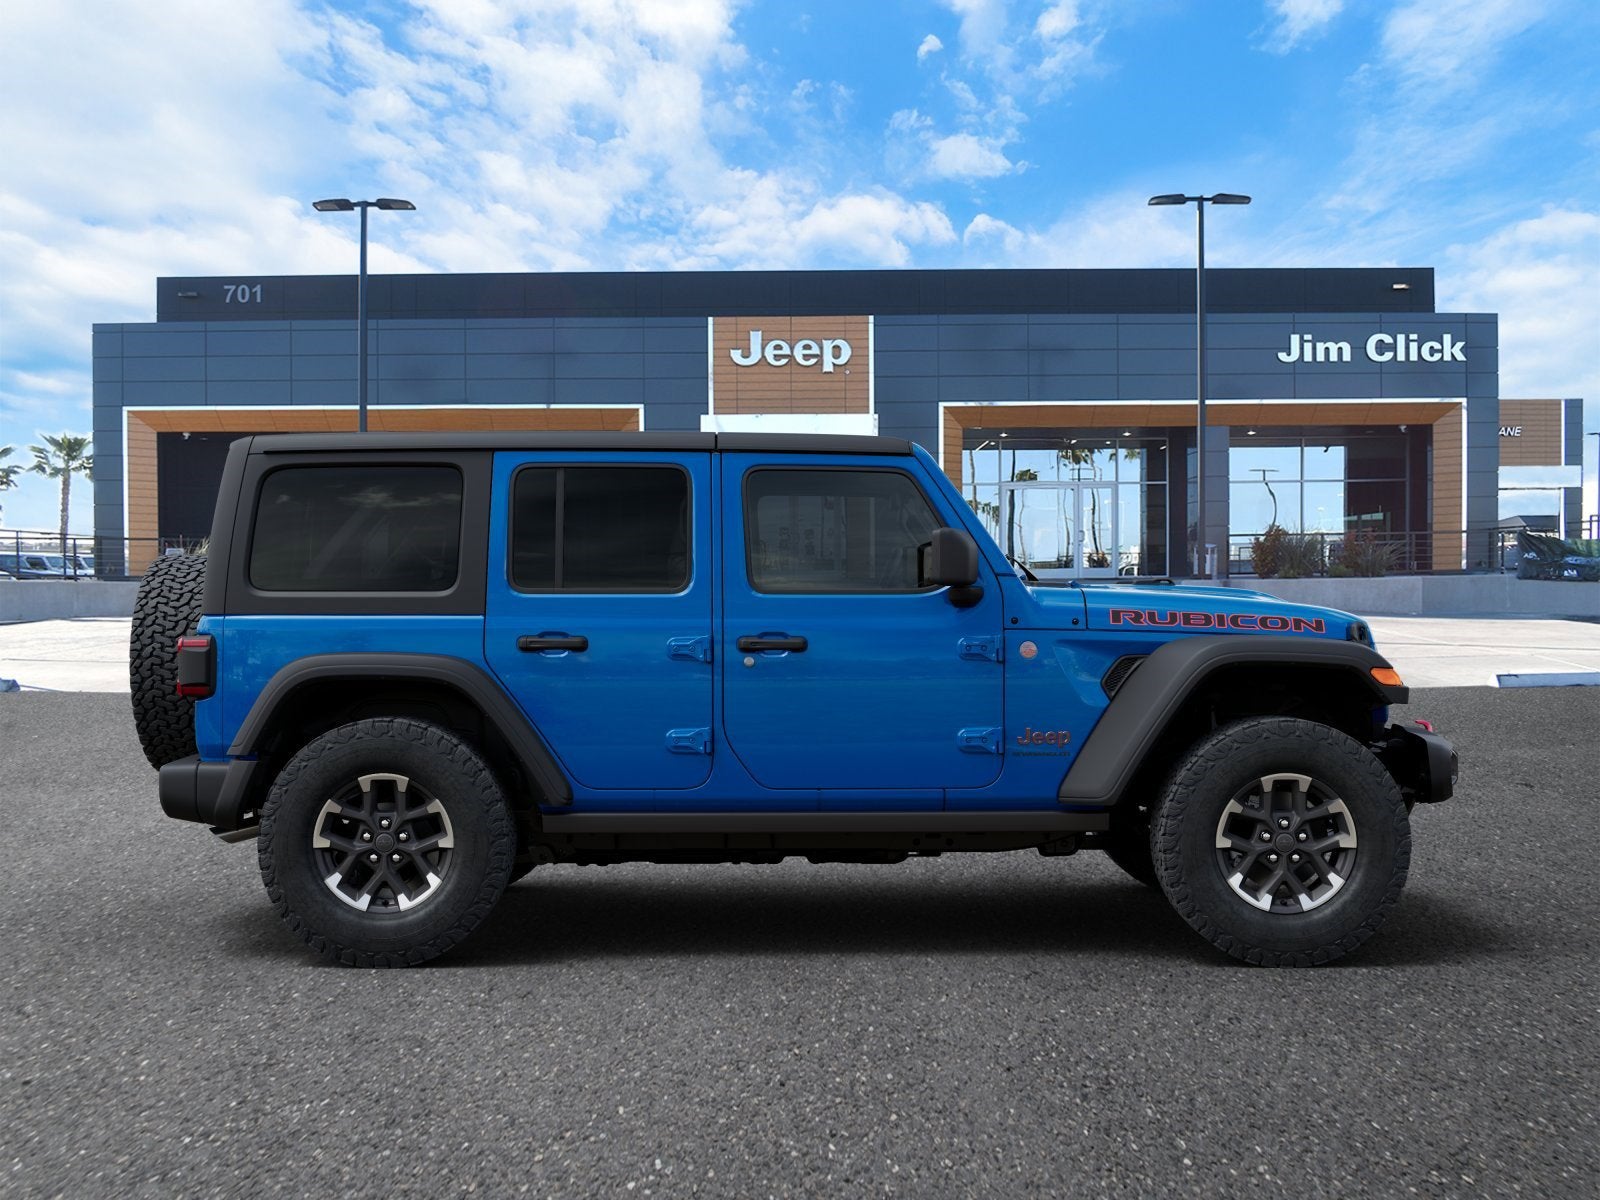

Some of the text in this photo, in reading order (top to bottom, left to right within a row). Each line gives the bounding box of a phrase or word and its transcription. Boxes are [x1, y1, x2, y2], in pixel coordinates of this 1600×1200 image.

[223, 284, 262, 303] 701
[729, 330, 852, 374] Jeep
[1277, 333, 1467, 362] Jim Click
[1109, 608, 1326, 634] RUBICON
[1016, 727, 1071, 749] Jeep
